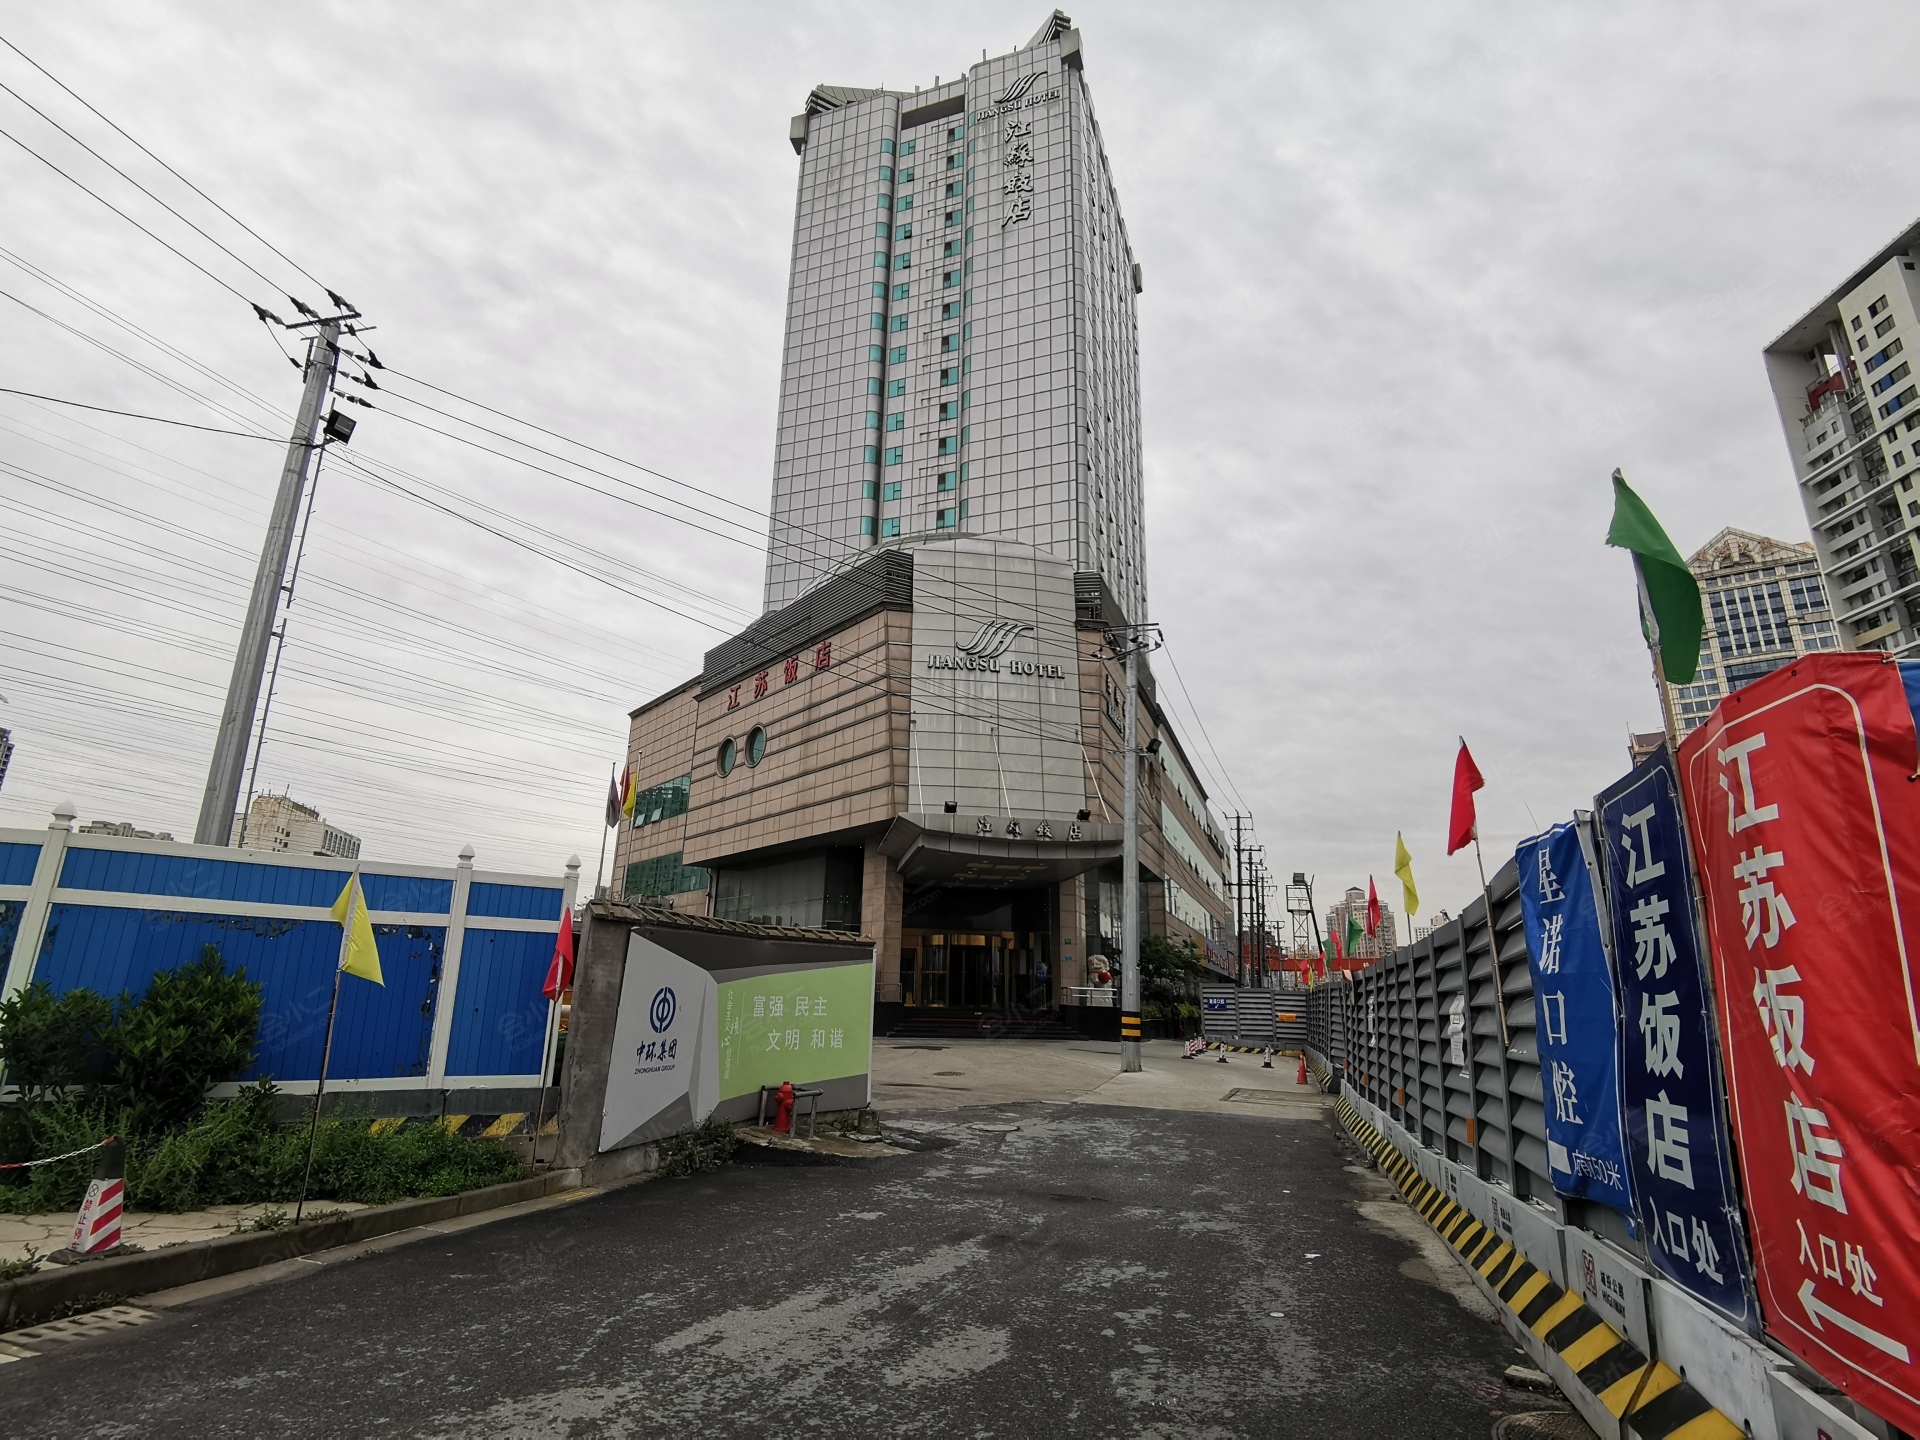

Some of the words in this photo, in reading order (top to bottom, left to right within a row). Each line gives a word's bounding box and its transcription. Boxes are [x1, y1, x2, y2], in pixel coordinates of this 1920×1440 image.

[976, 100, 1021, 122] JIANGSU
[1024, 90, 1061, 108] HOTEL
[727, 641, 832, 712] 江苏饭店
[928, 653, 1001, 674] JIANGSU
[1010, 659, 1066, 680] HOTEL
[1717, 732, 1848, 1215] 江苏饭店
[753, 995, 784, 1018] 富强
[795, 996, 828, 1018] 民主
[1620, 801, 1696, 1191] 江苏饭店
[637, 1038, 678, 1066] 中环集团
[766, 1028, 800, 1051] 文明
[811, 1027, 844, 1050] 和谐
[634, 1066, 661, 1075] ZHONGHUAN
[661, 1064, 676, 1072] GROUP
[1650, 1195, 1724, 1285] 入口处
[1797, 1217, 1884, 1307] 入口处
